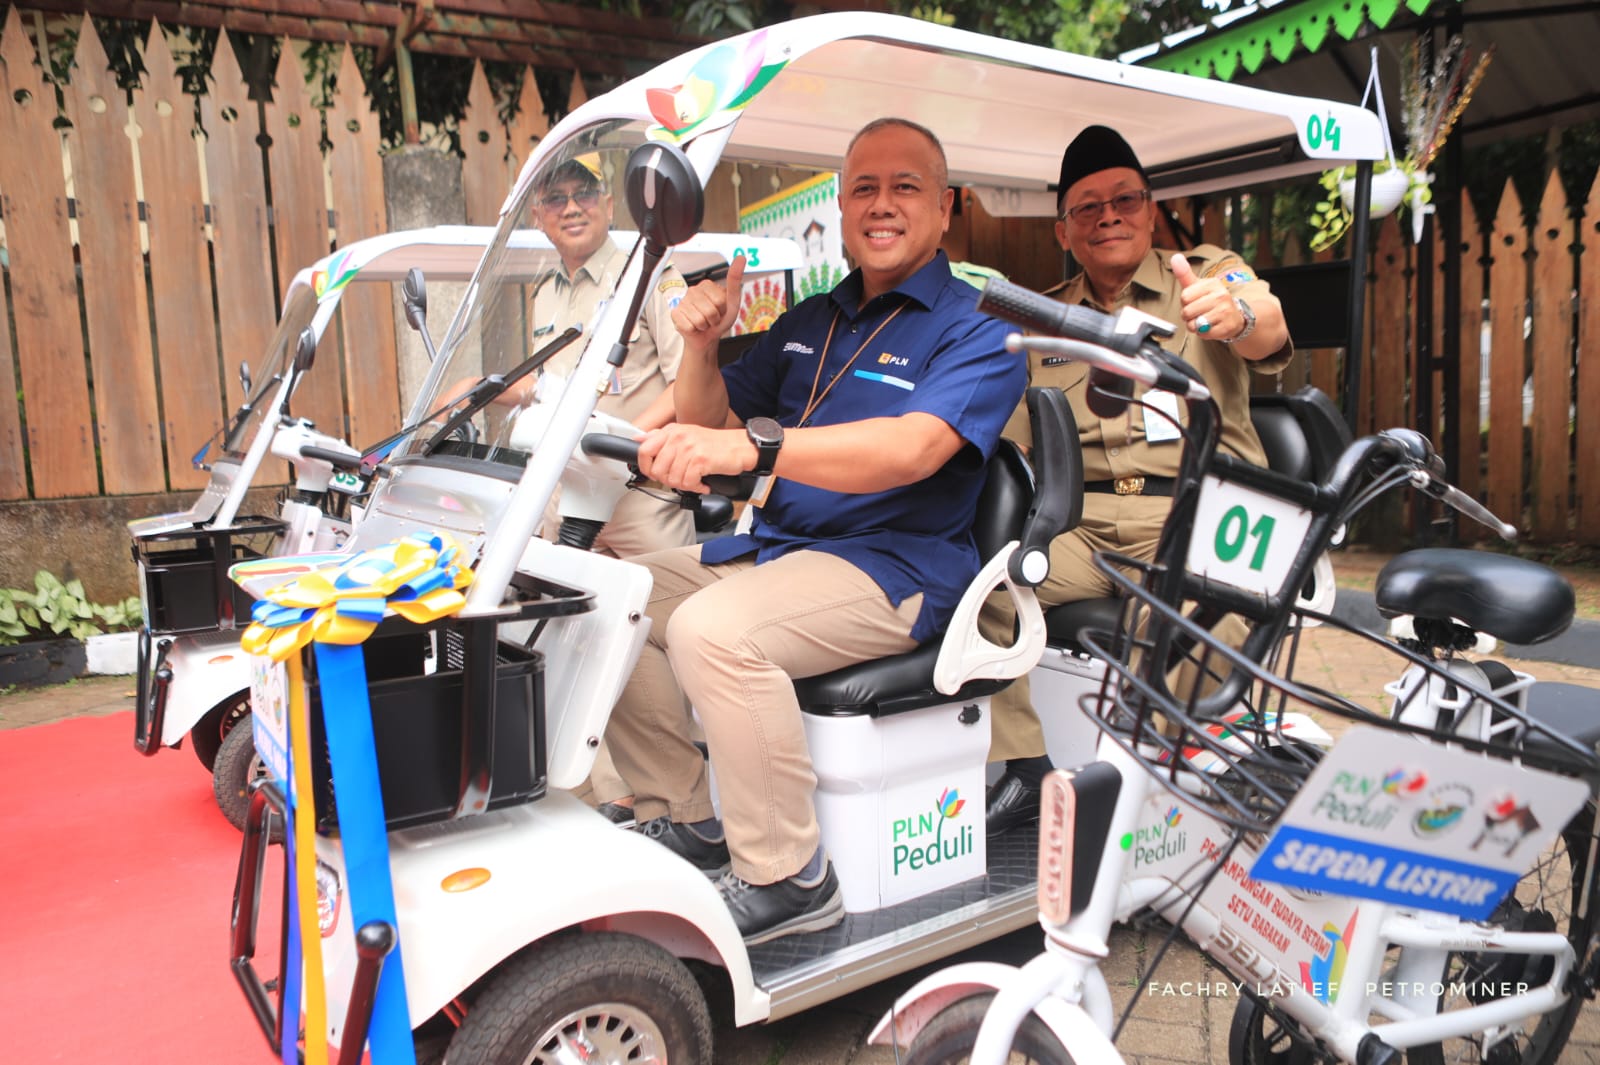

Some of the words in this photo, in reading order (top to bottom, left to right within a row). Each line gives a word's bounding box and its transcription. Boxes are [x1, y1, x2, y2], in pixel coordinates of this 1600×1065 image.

[1306, 113, 1341, 151] 04
[889, 357, 909, 366] PLN
[1213, 504, 1277, 572] 01
[893, 811, 932, 842] PLN
[1136, 823, 1162, 846] PLN
[893, 824, 972, 876] Peduli
[1134, 831, 1187, 869] Peduli
[1273, 839, 1387, 886] SEPEDA
[1384, 863, 1498, 906] LISTRIK
[1227, 894, 1252, 924] SETU
[1251, 912, 1291, 954] BABAKAN
[1271, 897, 1303, 936] BUDAYA
[1301, 924, 1331, 958] BETAWI
